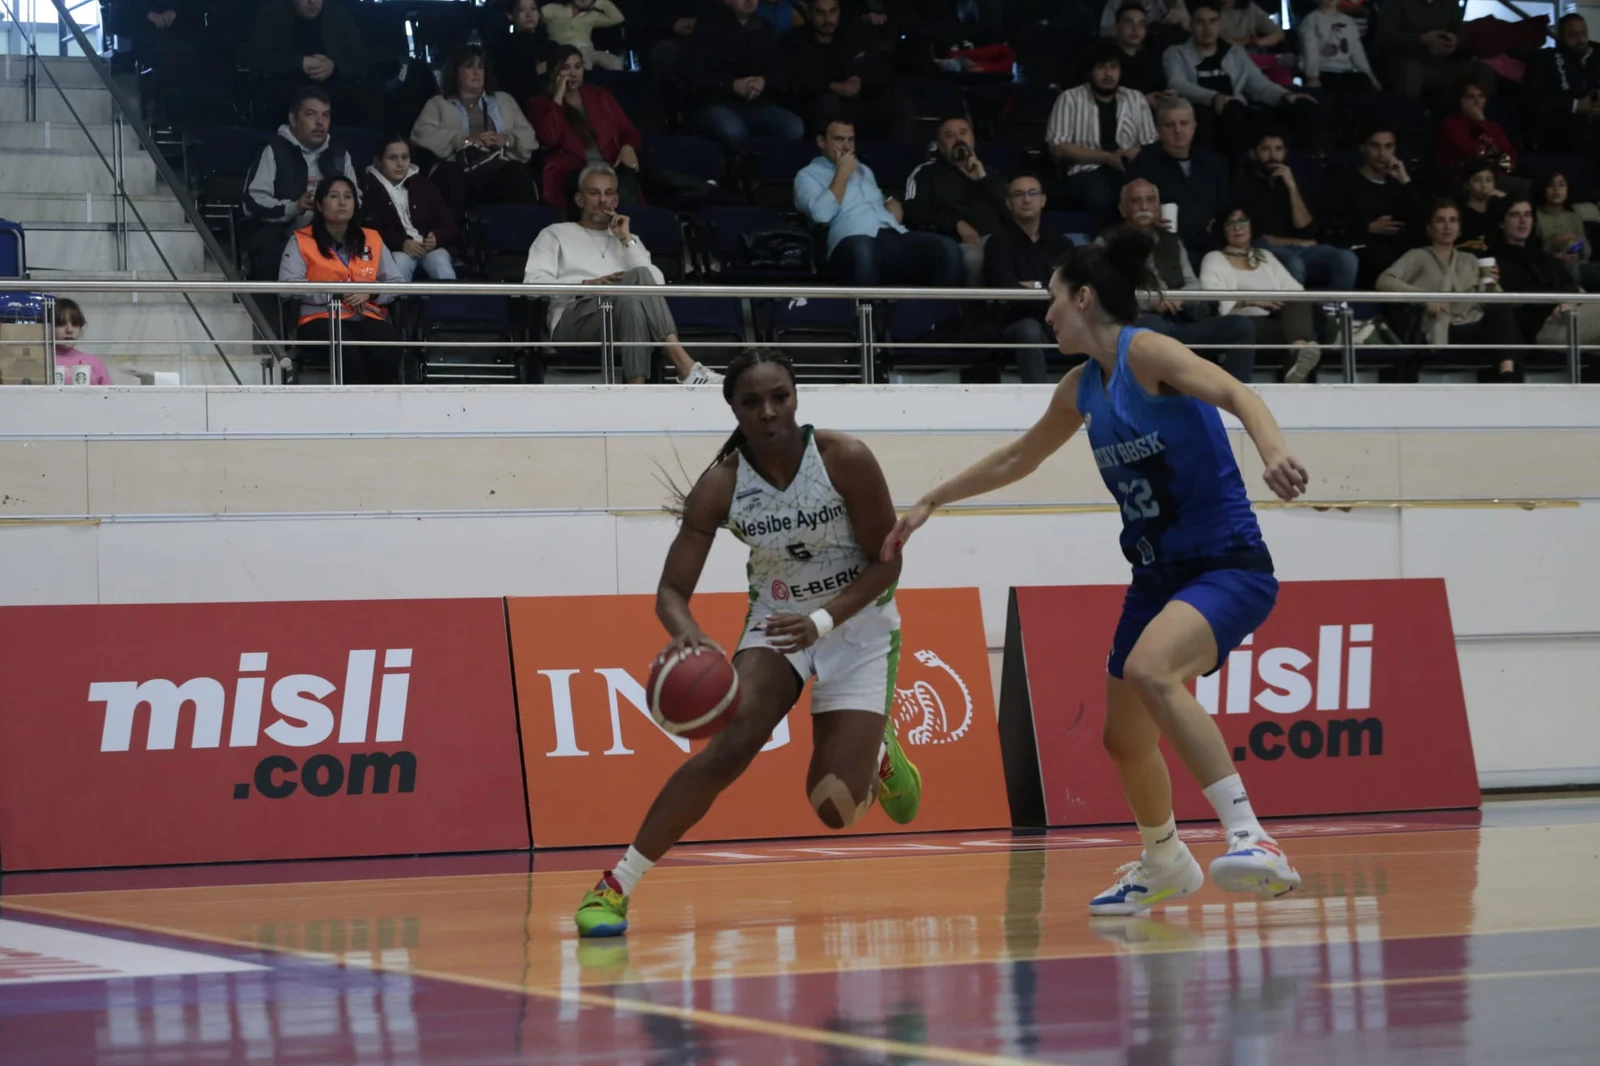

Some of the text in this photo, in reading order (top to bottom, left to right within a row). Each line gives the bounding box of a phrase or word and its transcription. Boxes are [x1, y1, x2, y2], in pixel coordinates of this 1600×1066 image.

[790, 564, 861, 598] E-BERK
[88, 648, 413, 752] misli
[1196, 623, 1374, 716] isli
[537, 667, 792, 758] IN
[1233, 717, 1383, 761] .com
[233, 751, 417, 800] .com
